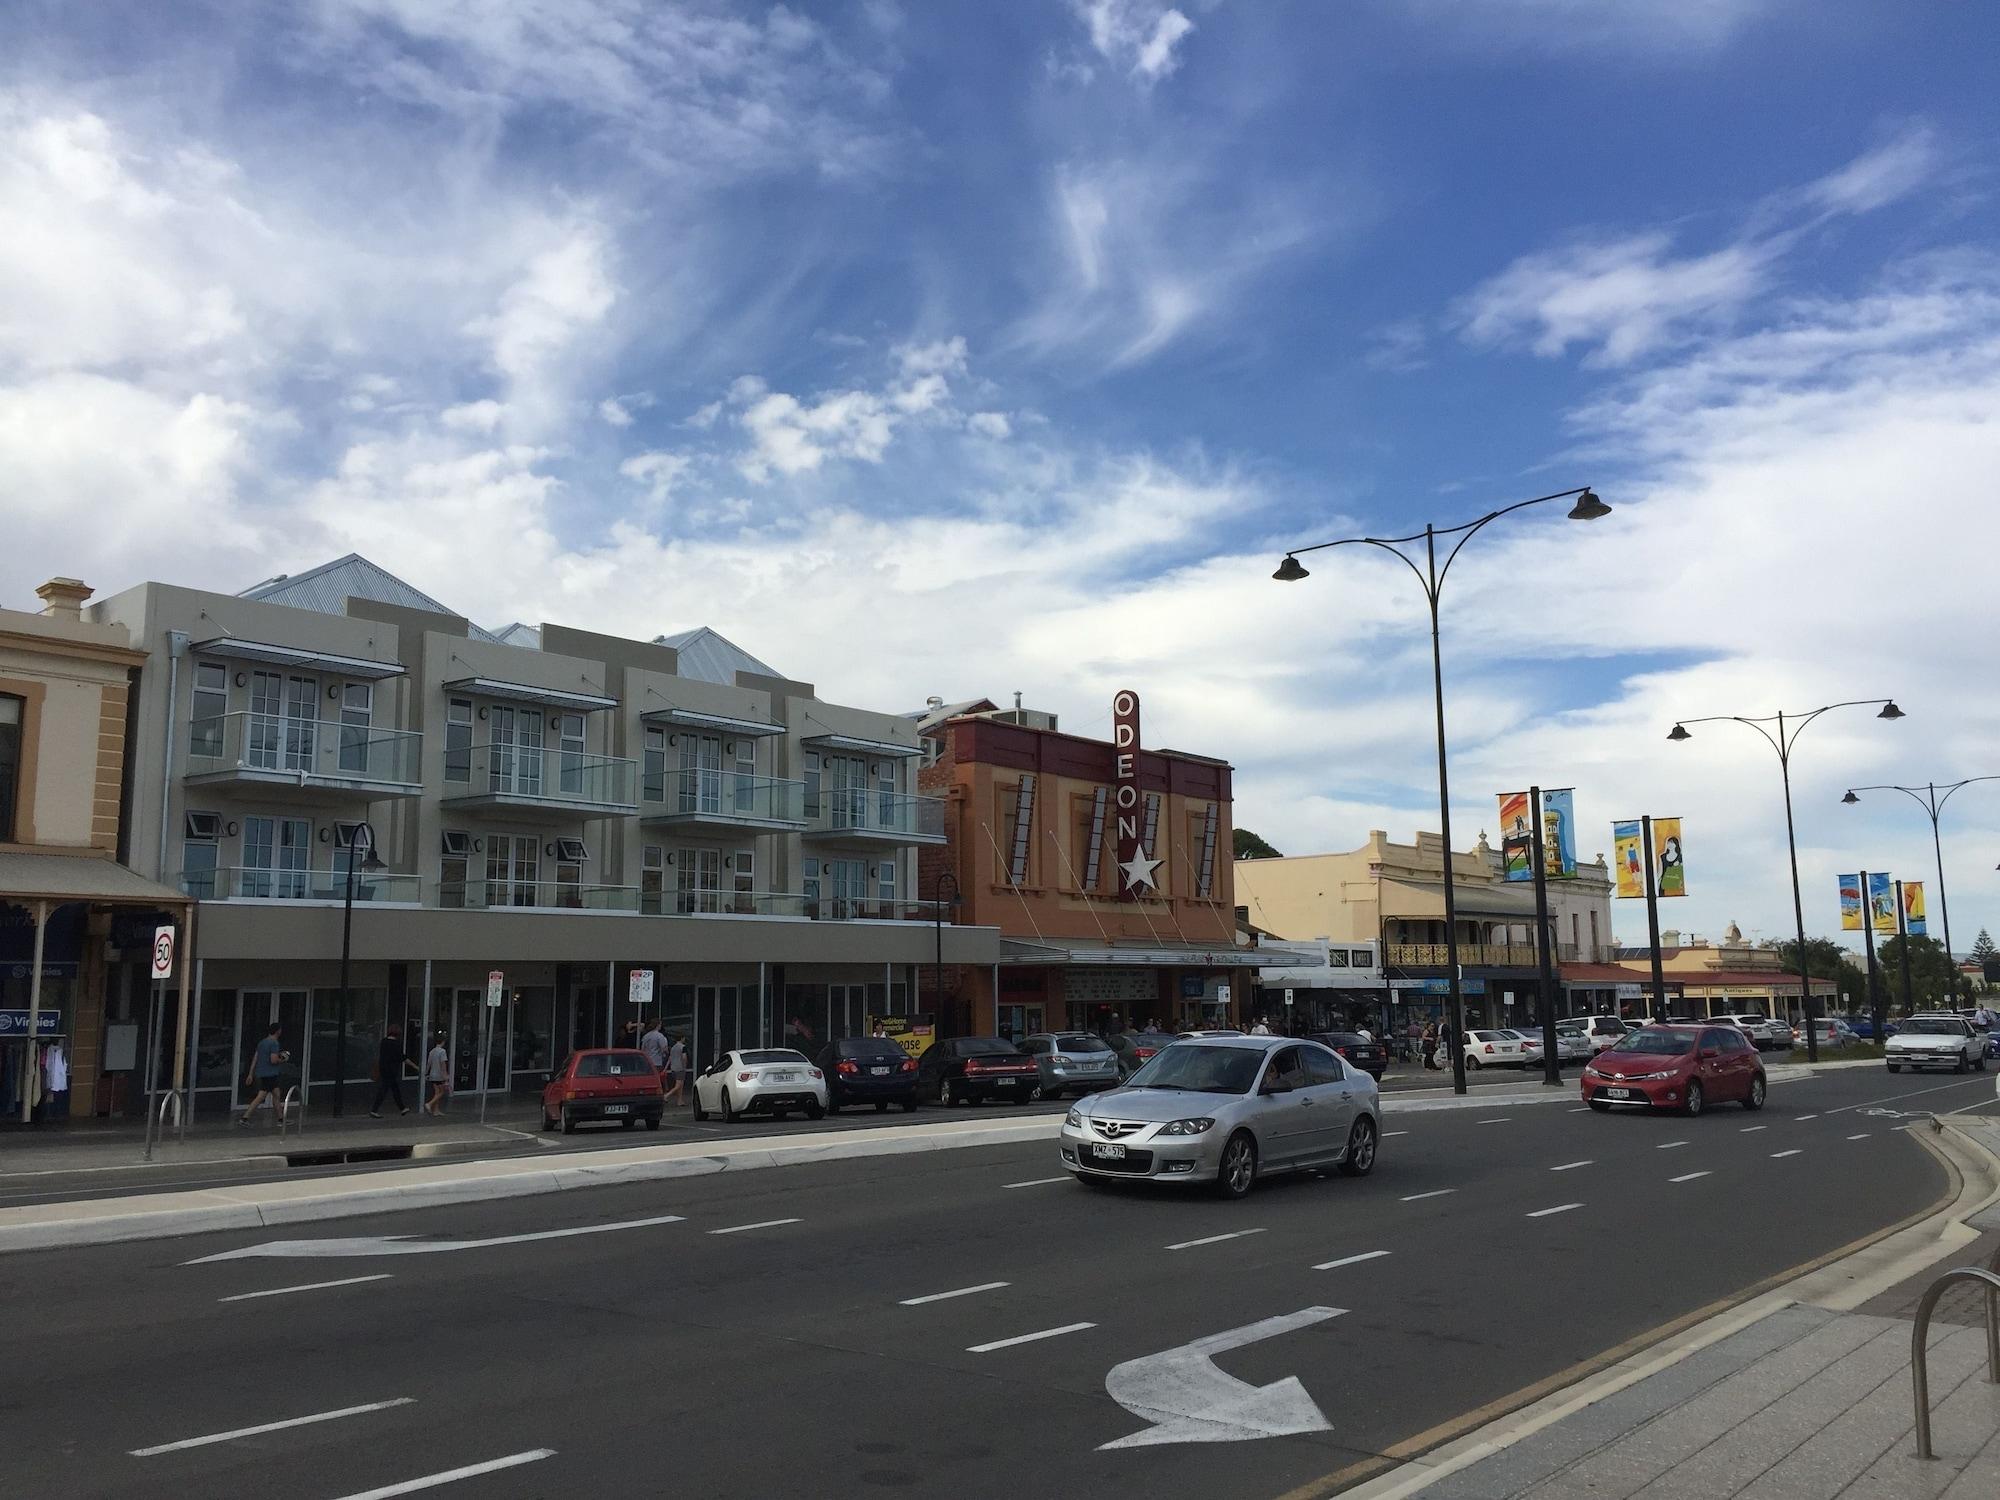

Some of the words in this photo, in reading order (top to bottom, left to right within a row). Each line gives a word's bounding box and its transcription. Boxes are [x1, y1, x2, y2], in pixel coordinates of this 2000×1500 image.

[1114, 693, 1137, 841] ODEON
[157, 943, 170, 962] 50
[28, 967, 62, 976] Vnies
[899, 1039, 921, 1050] ease
[1094, 1145, 1107, 1154] XMZ
[1112, 1146, 1124, 1156] 575
